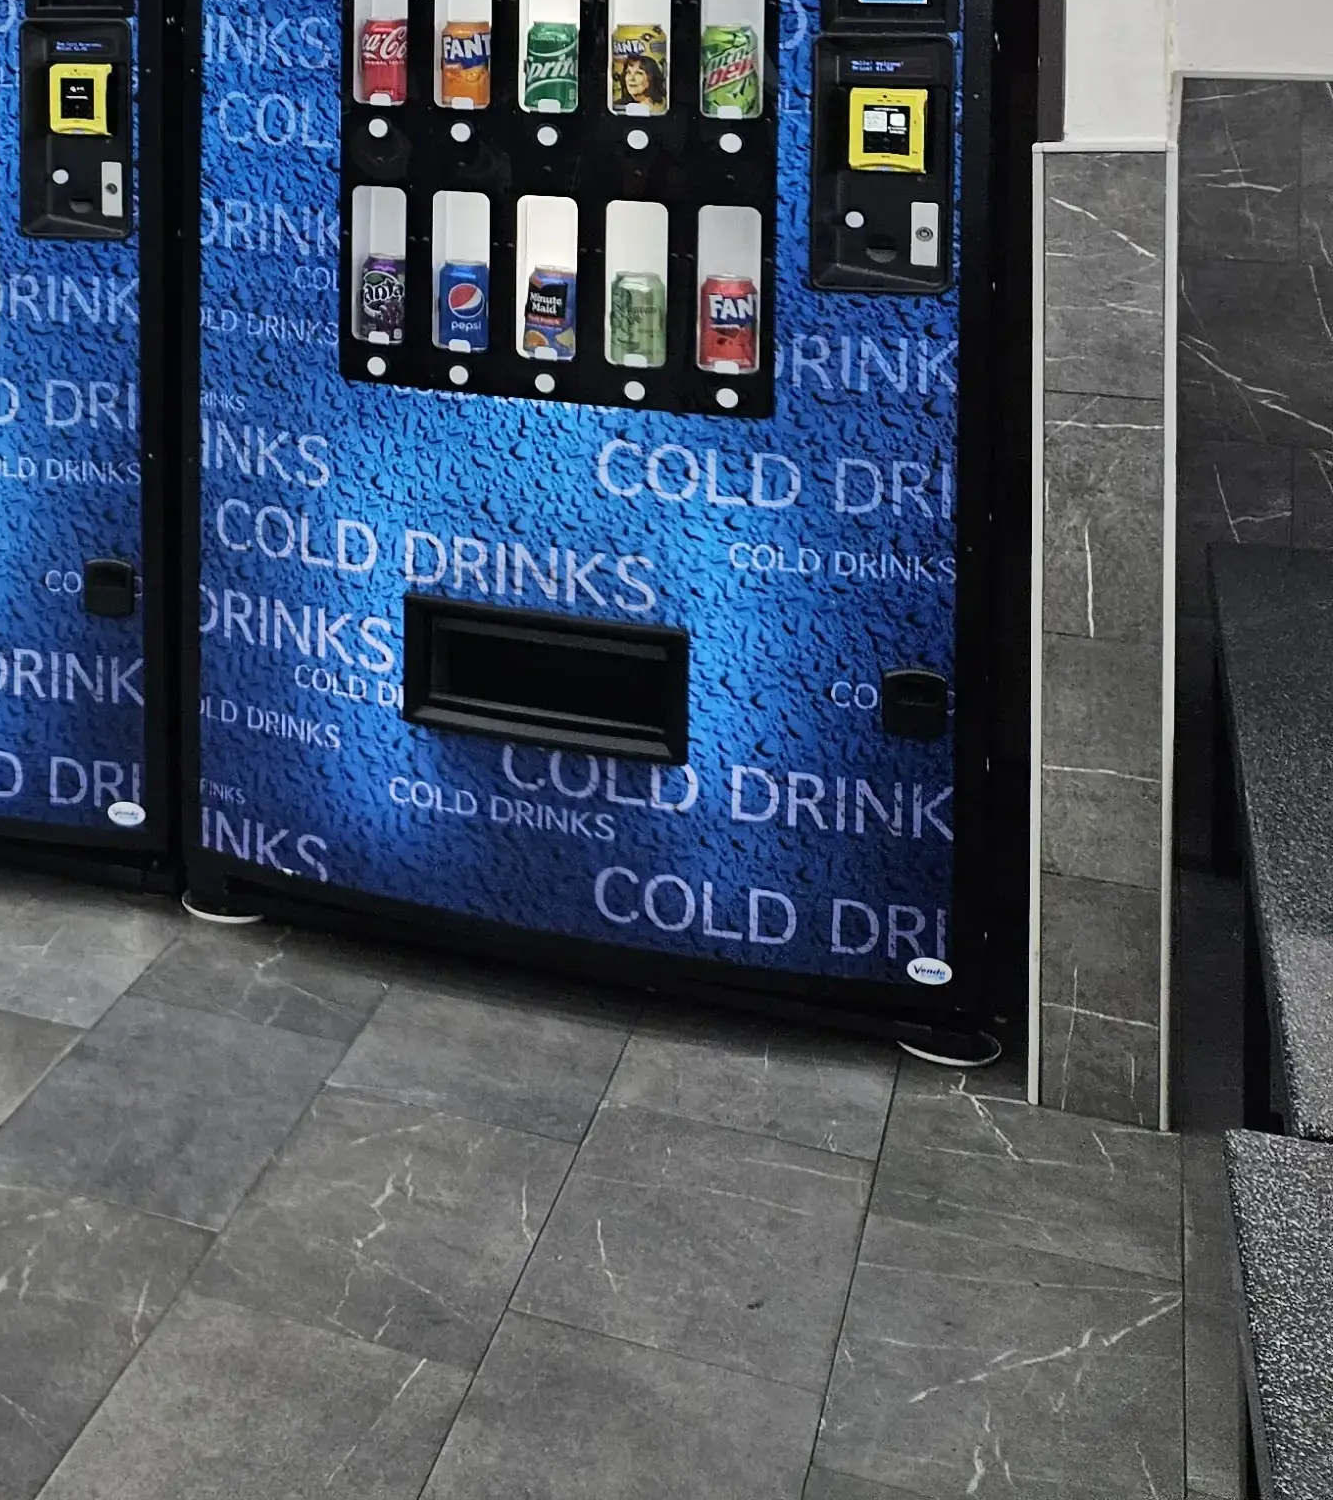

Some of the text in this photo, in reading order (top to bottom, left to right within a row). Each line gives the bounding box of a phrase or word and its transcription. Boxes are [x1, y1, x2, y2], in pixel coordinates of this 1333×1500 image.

[204, 13, 333, 69] INKS
[200, 306, 340, 346] LD DRINKS
[450, 319, 482, 331] pepsi
[529, 291, 563, 306] Minute
[531, 302, 558, 315] Maid
[774, 332, 958, 395] RINK
[45, 379, 136, 430] DRI
[46, 457, 141, 485] DRINKS
[200, 417, 331, 488] INKS
[596, 438, 952, 520] COLD DRI
[217, 498, 658, 613] COLD DRINKS
[728, 542, 957, 585] COLD DRINKS
[199, 583, 394, 673] DRINKS
[294, 664, 367, 700] COLD
[200, 694, 341, 750] LD DRINKS
[49, 755, 140, 807] DRI
[389, 776, 615, 842] COLD DRINKS
[501, 743, 954, 841] COLD DRINK
[201, 806, 329, 883] INKS
[594, 865, 946, 960] COLD DRI
